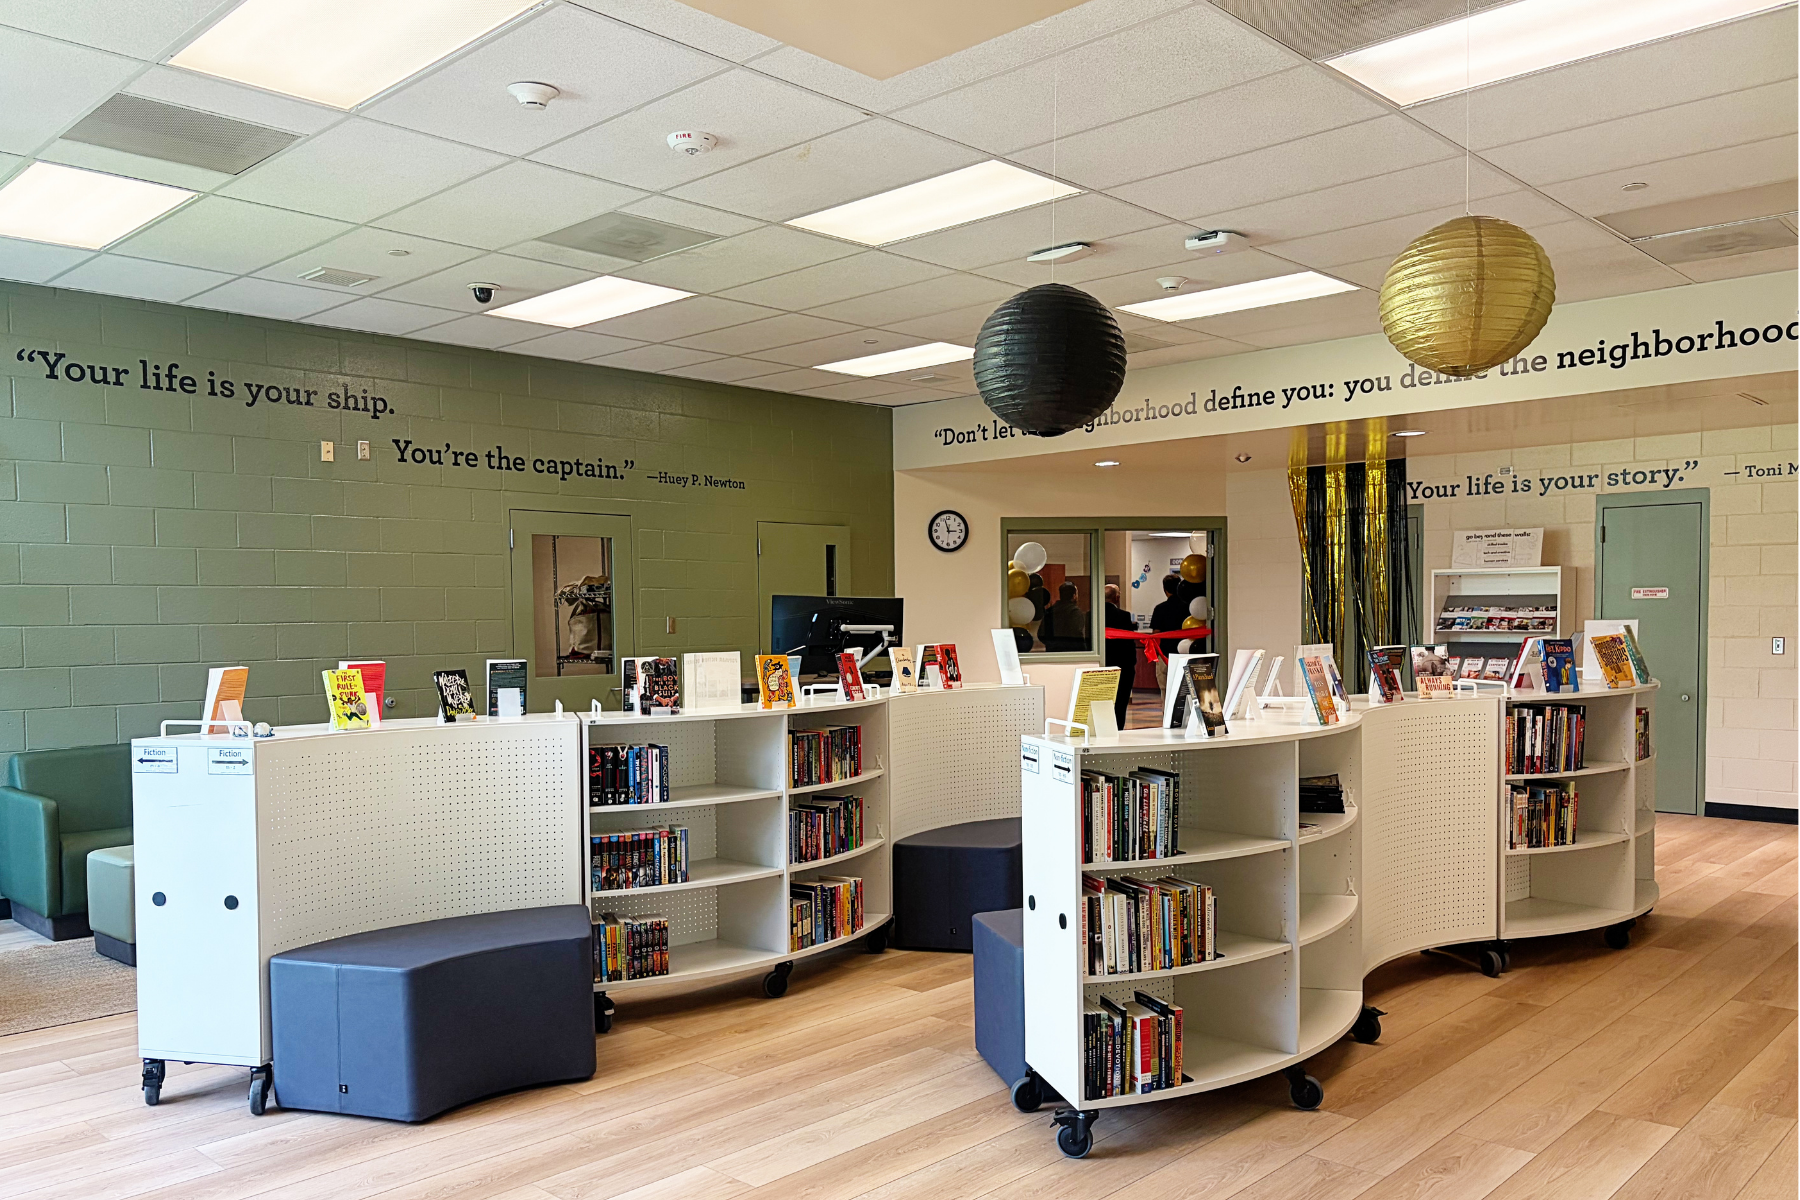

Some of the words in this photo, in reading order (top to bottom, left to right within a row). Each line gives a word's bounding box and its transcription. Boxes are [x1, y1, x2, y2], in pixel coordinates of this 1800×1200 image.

[140, 359, 197, 394] life
[207, 371, 235, 398] is
[244, 382, 318, 408] your
[327, 383, 395, 419] ship.
[992, 420, 1016, 440] let
[1203, 387, 1276, 413] define
[1282, 381, 1335, 410] you:
[1344, 376, 1392, 402] you
[1499, 354, 1548, 377] the
[485, 446, 526, 472] the
[691, 474, 702, 487] P.
[704, 475, 746, 490] Newton
[1407, 480, 1460, 500] Your
[1466, 474, 1505, 496] life
[1512, 473, 1532, 493] is
[1539, 473, 1599, 497] your
[1745, 463, 1783, 478] Toni
